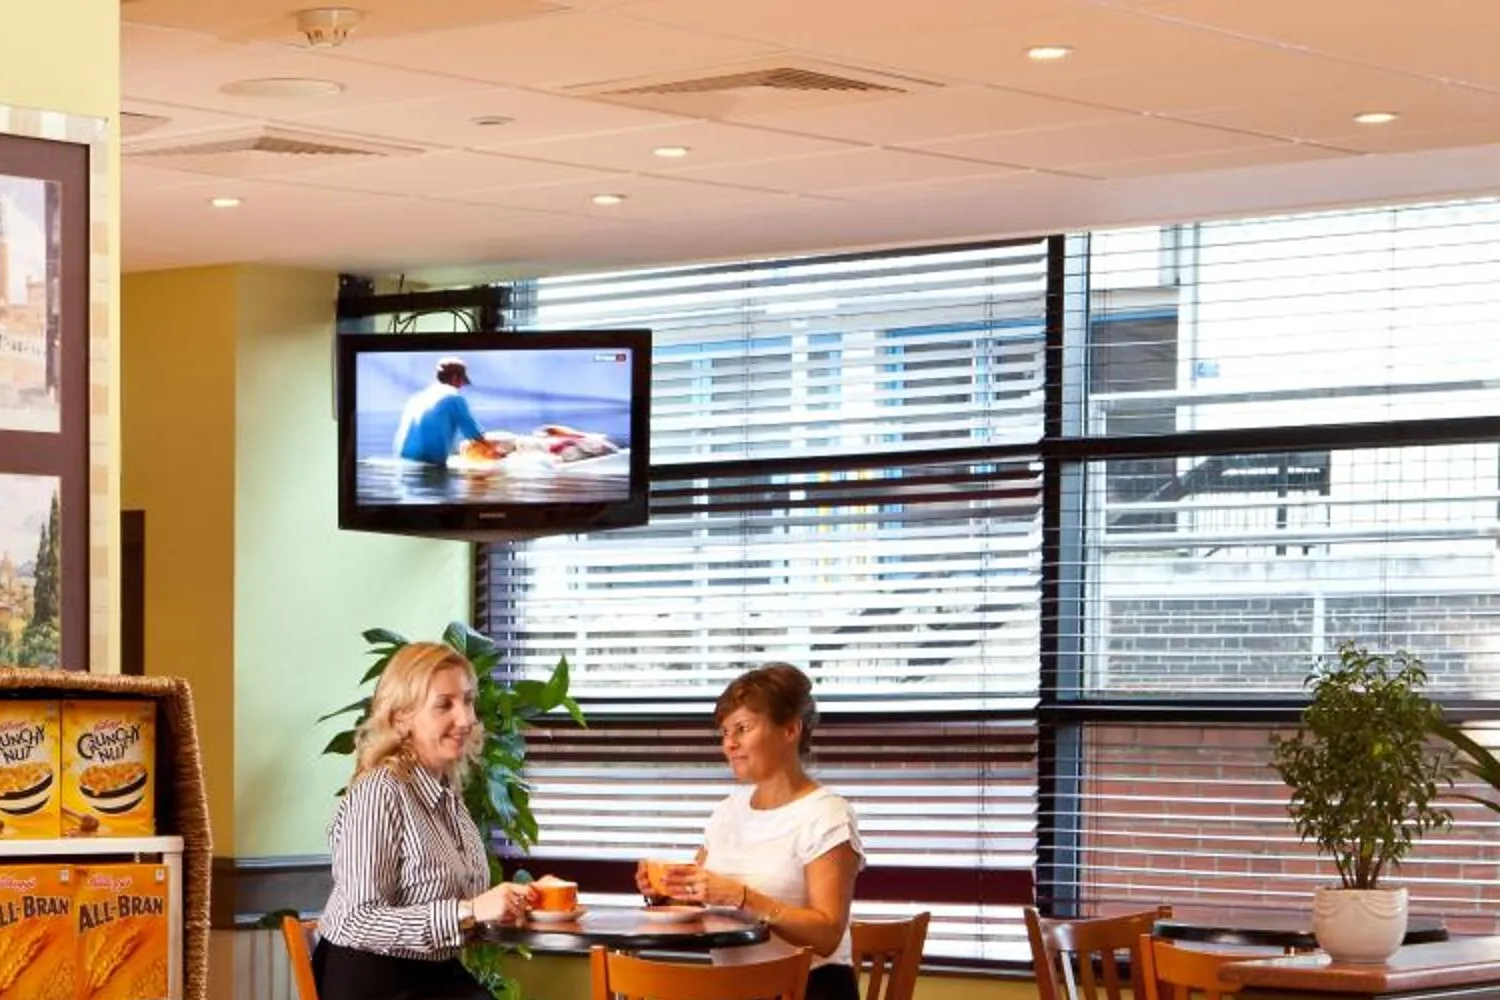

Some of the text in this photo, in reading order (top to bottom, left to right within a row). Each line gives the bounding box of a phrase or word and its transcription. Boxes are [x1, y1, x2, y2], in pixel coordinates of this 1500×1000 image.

[3, 745, 34, 764] NUT
[98, 742, 128, 763] NUT
[80, 895, 163, 933] ALL-BRAN
